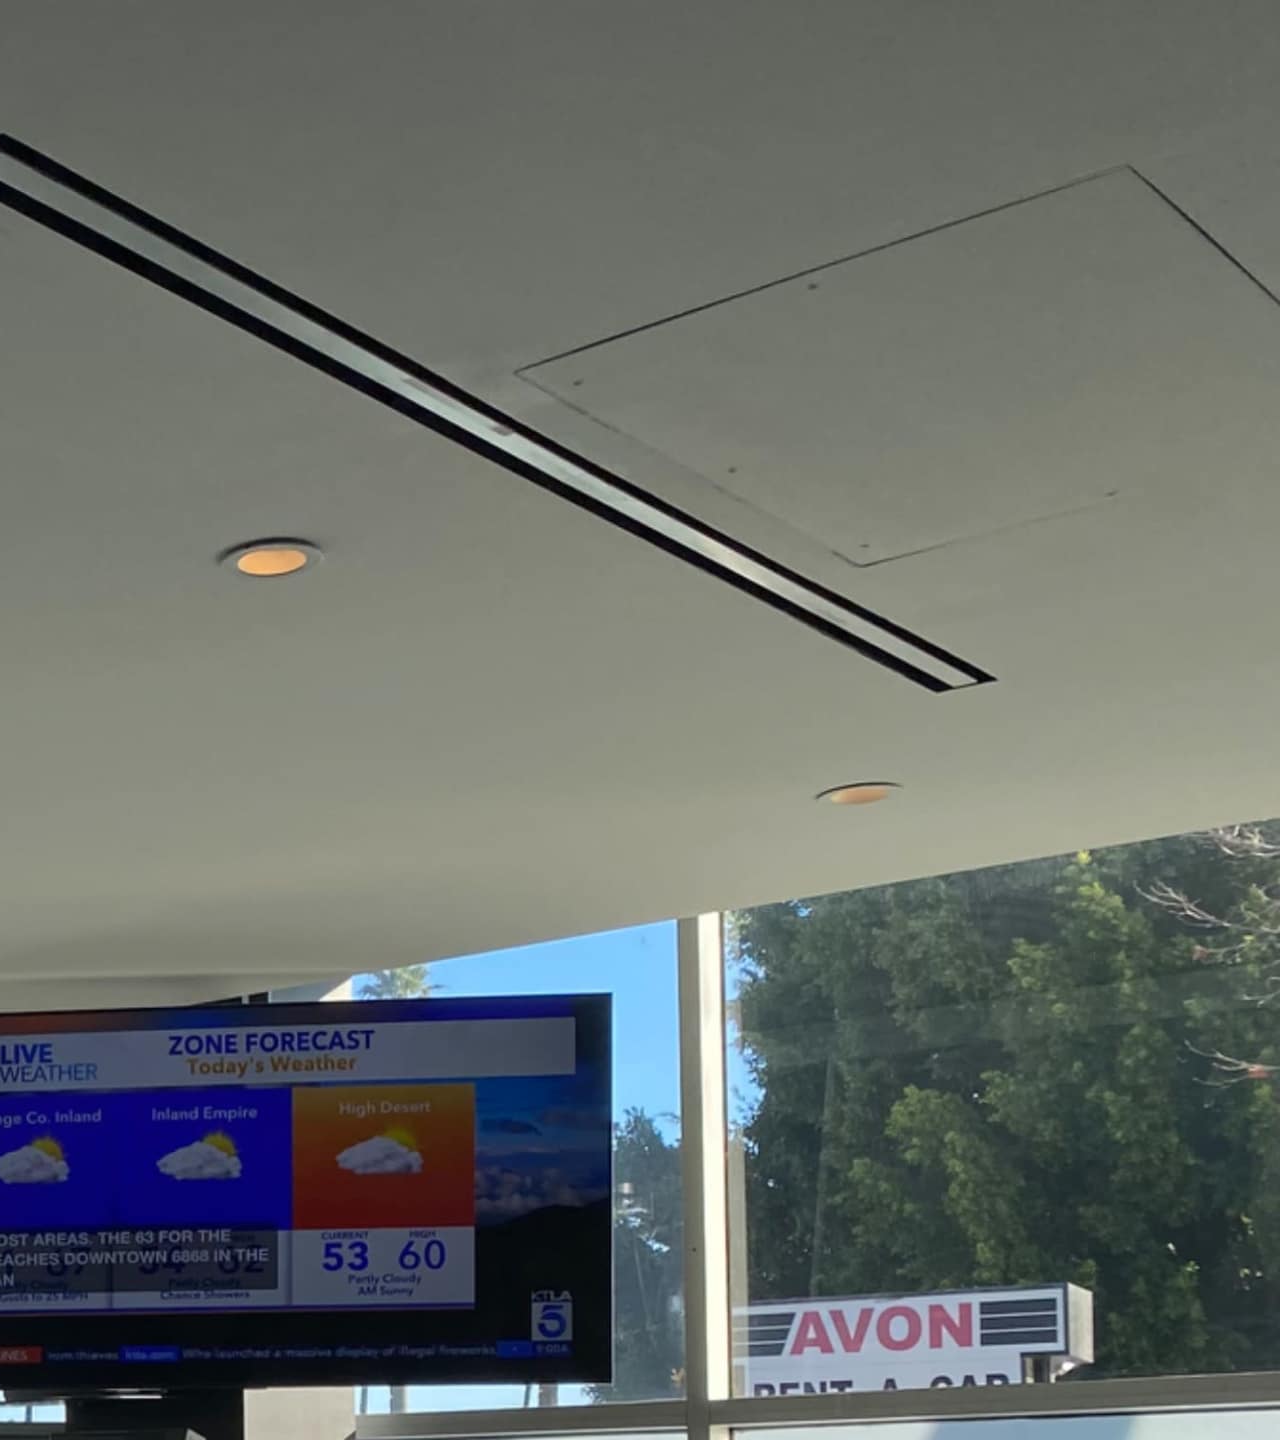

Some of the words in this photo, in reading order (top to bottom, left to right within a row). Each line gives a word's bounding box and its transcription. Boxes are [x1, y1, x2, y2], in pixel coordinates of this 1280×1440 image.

[169, 1034, 238, 1055] ZONE
[245, 1030, 375, 1053] FORECAST
[1, 1044, 53, 1065] LIVE
[0, 1063, 98, 1083] WEATHER
[186, 1057, 264, 1078] Today's
[269, 1054, 357, 1072] Weather
[26, 1111, 51, 1125] Co.
[55, 1109, 102, 1124] Inland
[152, 1107, 198, 1121] Inland
[203, 1106, 258, 1123] Empire
[340, 1102, 376, 1117] High
[380, 1100, 431, 1114] Desert
[34, 1232, 93, 1247] AREAS.
[97, 1231, 131, 1245] THE
[158, 1230, 193, 1243] FOR
[197, 1228, 232, 1242] THE
[321, 1231, 369, 1240] CURRENT
[408, 1230, 437, 1239] HIGH
[64, 1249, 167, 1266] DOWNTOWN
[214, 1249, 231, 1262] IN
[233, 1248, 270, 1262] THE
[322, 1241, 369, 1271] 53
[398, 1239, 446, 1270] 60
[347, 1273, 380, 1285] Partly
[382, 1272, 422, 1285] Cloudy
[357, 1286, 377, 1296] AM
[380, 1285, 414, 1297] Sunny
[537, 1304, 566, 1338] 5
[790, 1302, 973, 1355] AVON
